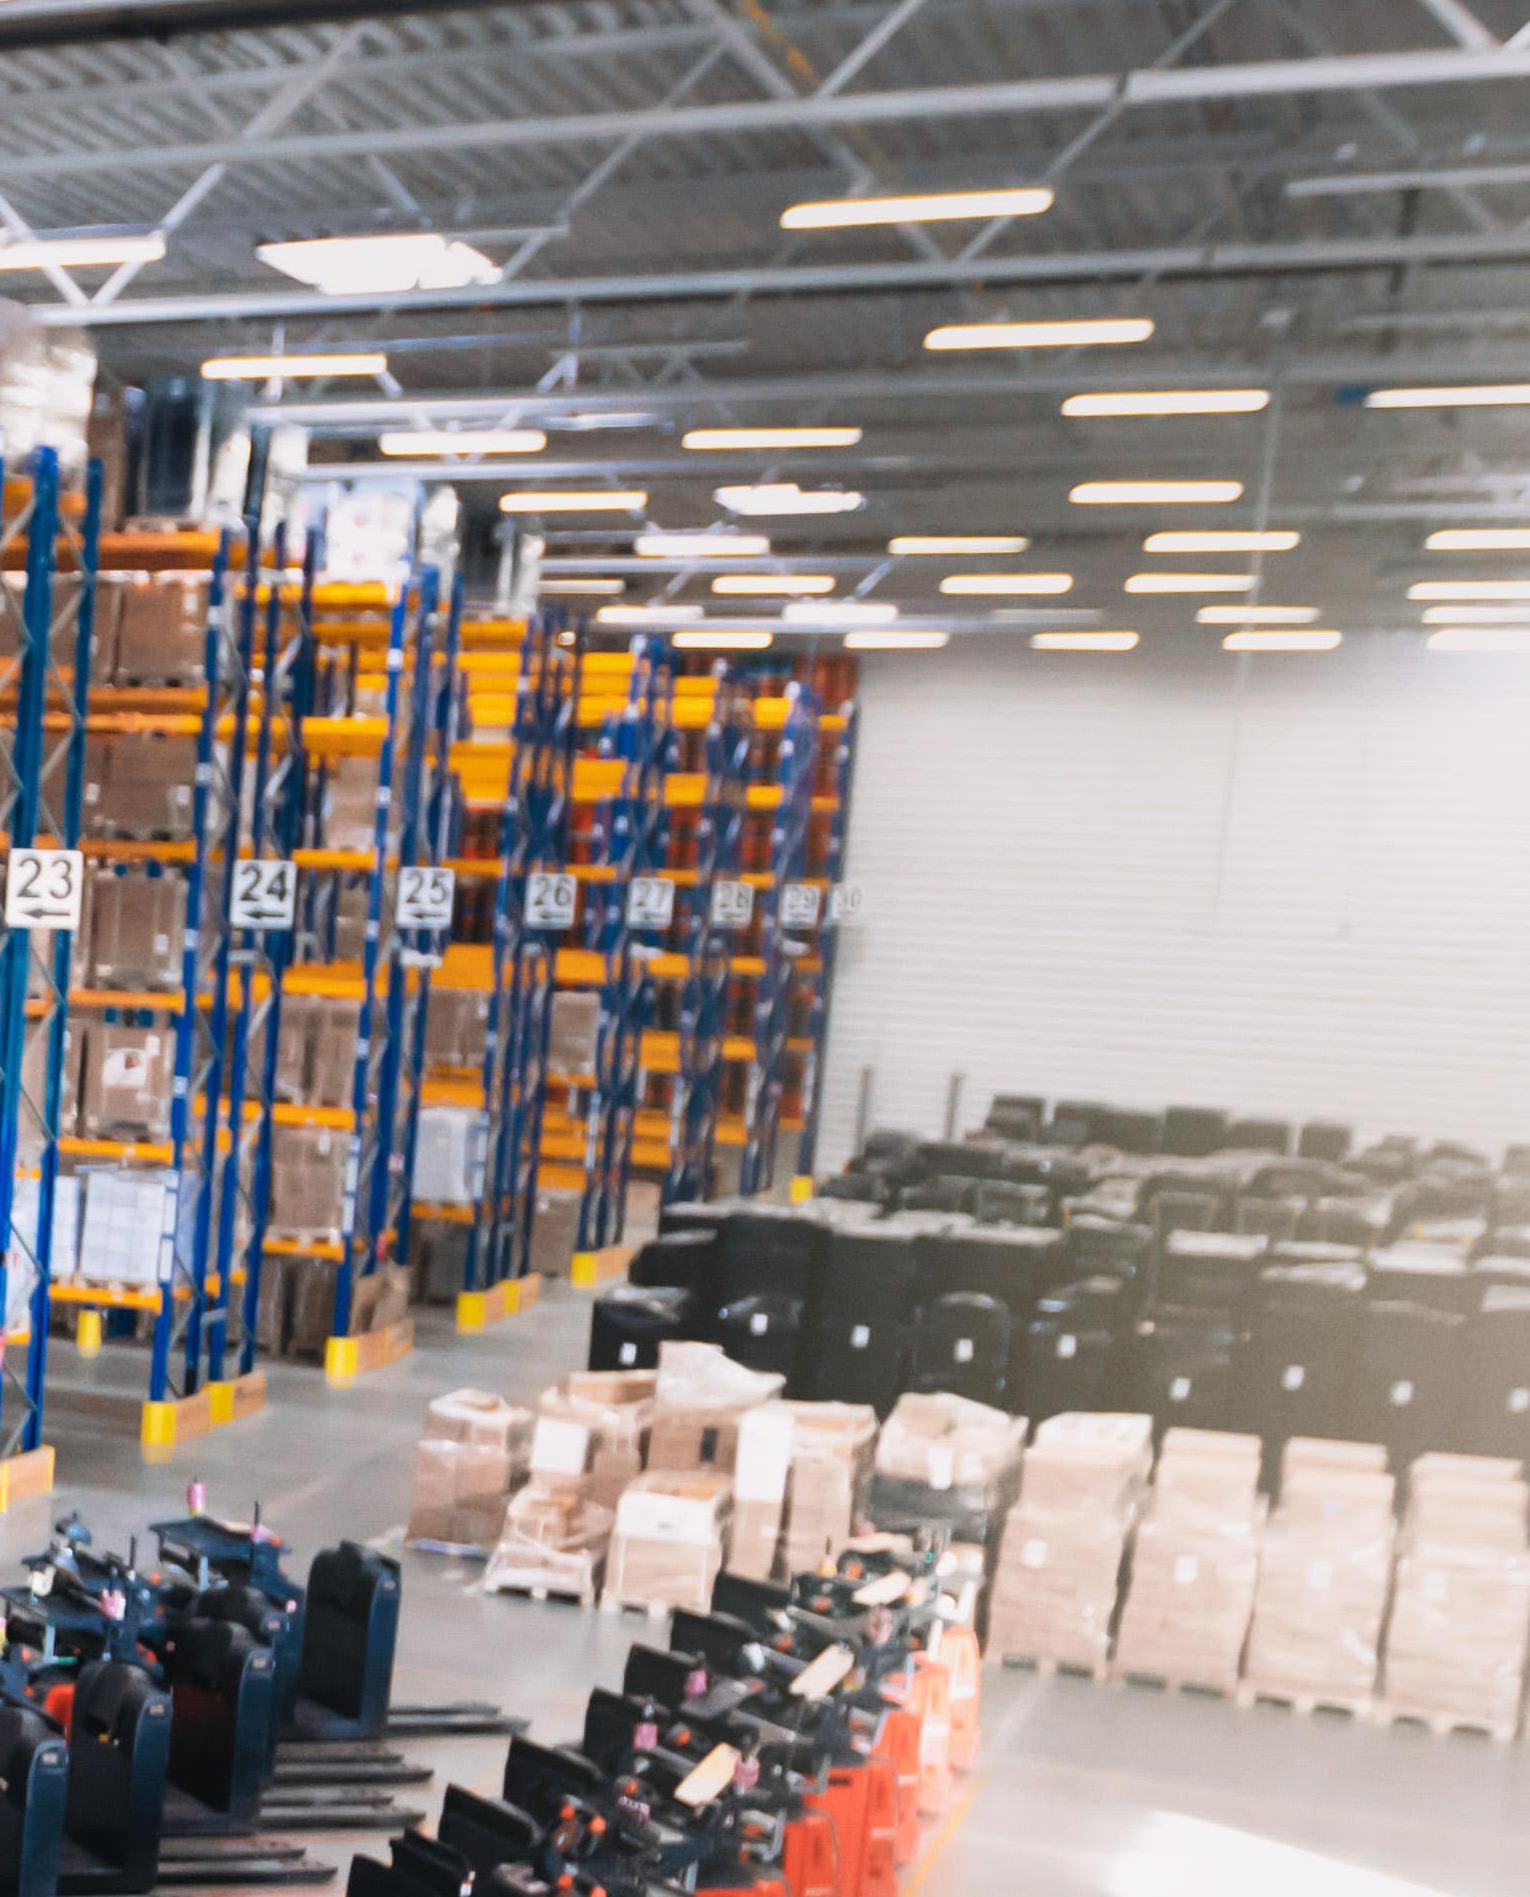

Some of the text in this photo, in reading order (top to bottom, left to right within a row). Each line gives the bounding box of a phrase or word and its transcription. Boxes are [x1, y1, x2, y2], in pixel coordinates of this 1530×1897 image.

[15, 857, 73, 900] 23
[239, 862, 288, 902] 24
[405, 870, 450, 904] 25
[533, 875, 572, 907] 26
[635, 880, 670, 908] 27
